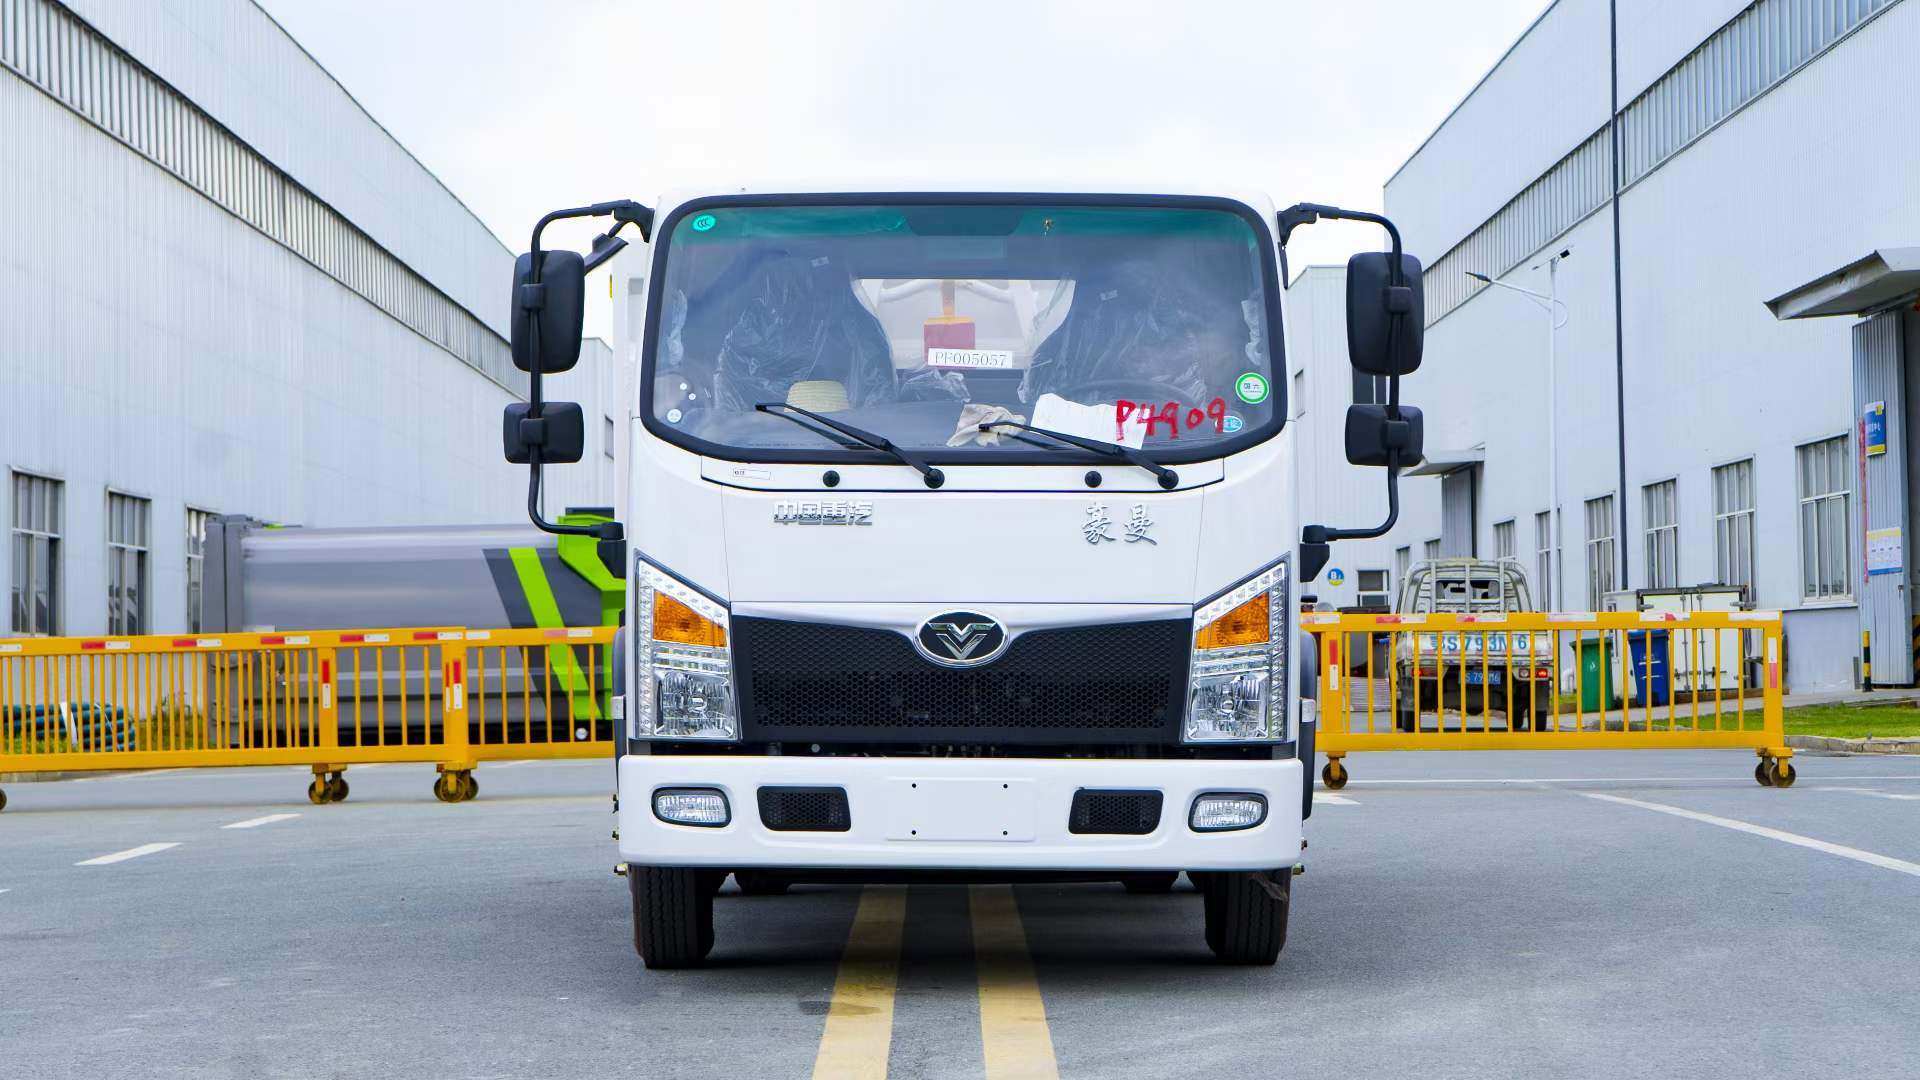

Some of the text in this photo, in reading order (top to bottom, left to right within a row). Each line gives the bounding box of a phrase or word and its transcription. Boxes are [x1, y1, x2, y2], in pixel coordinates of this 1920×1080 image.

[935, 351, 1007, 367] PF005057
[1116, 396, 1226, 441] P4909
[774, 500, 873, 526] 中国重汽
[1082, 501, 1158, 546] 豪曼
